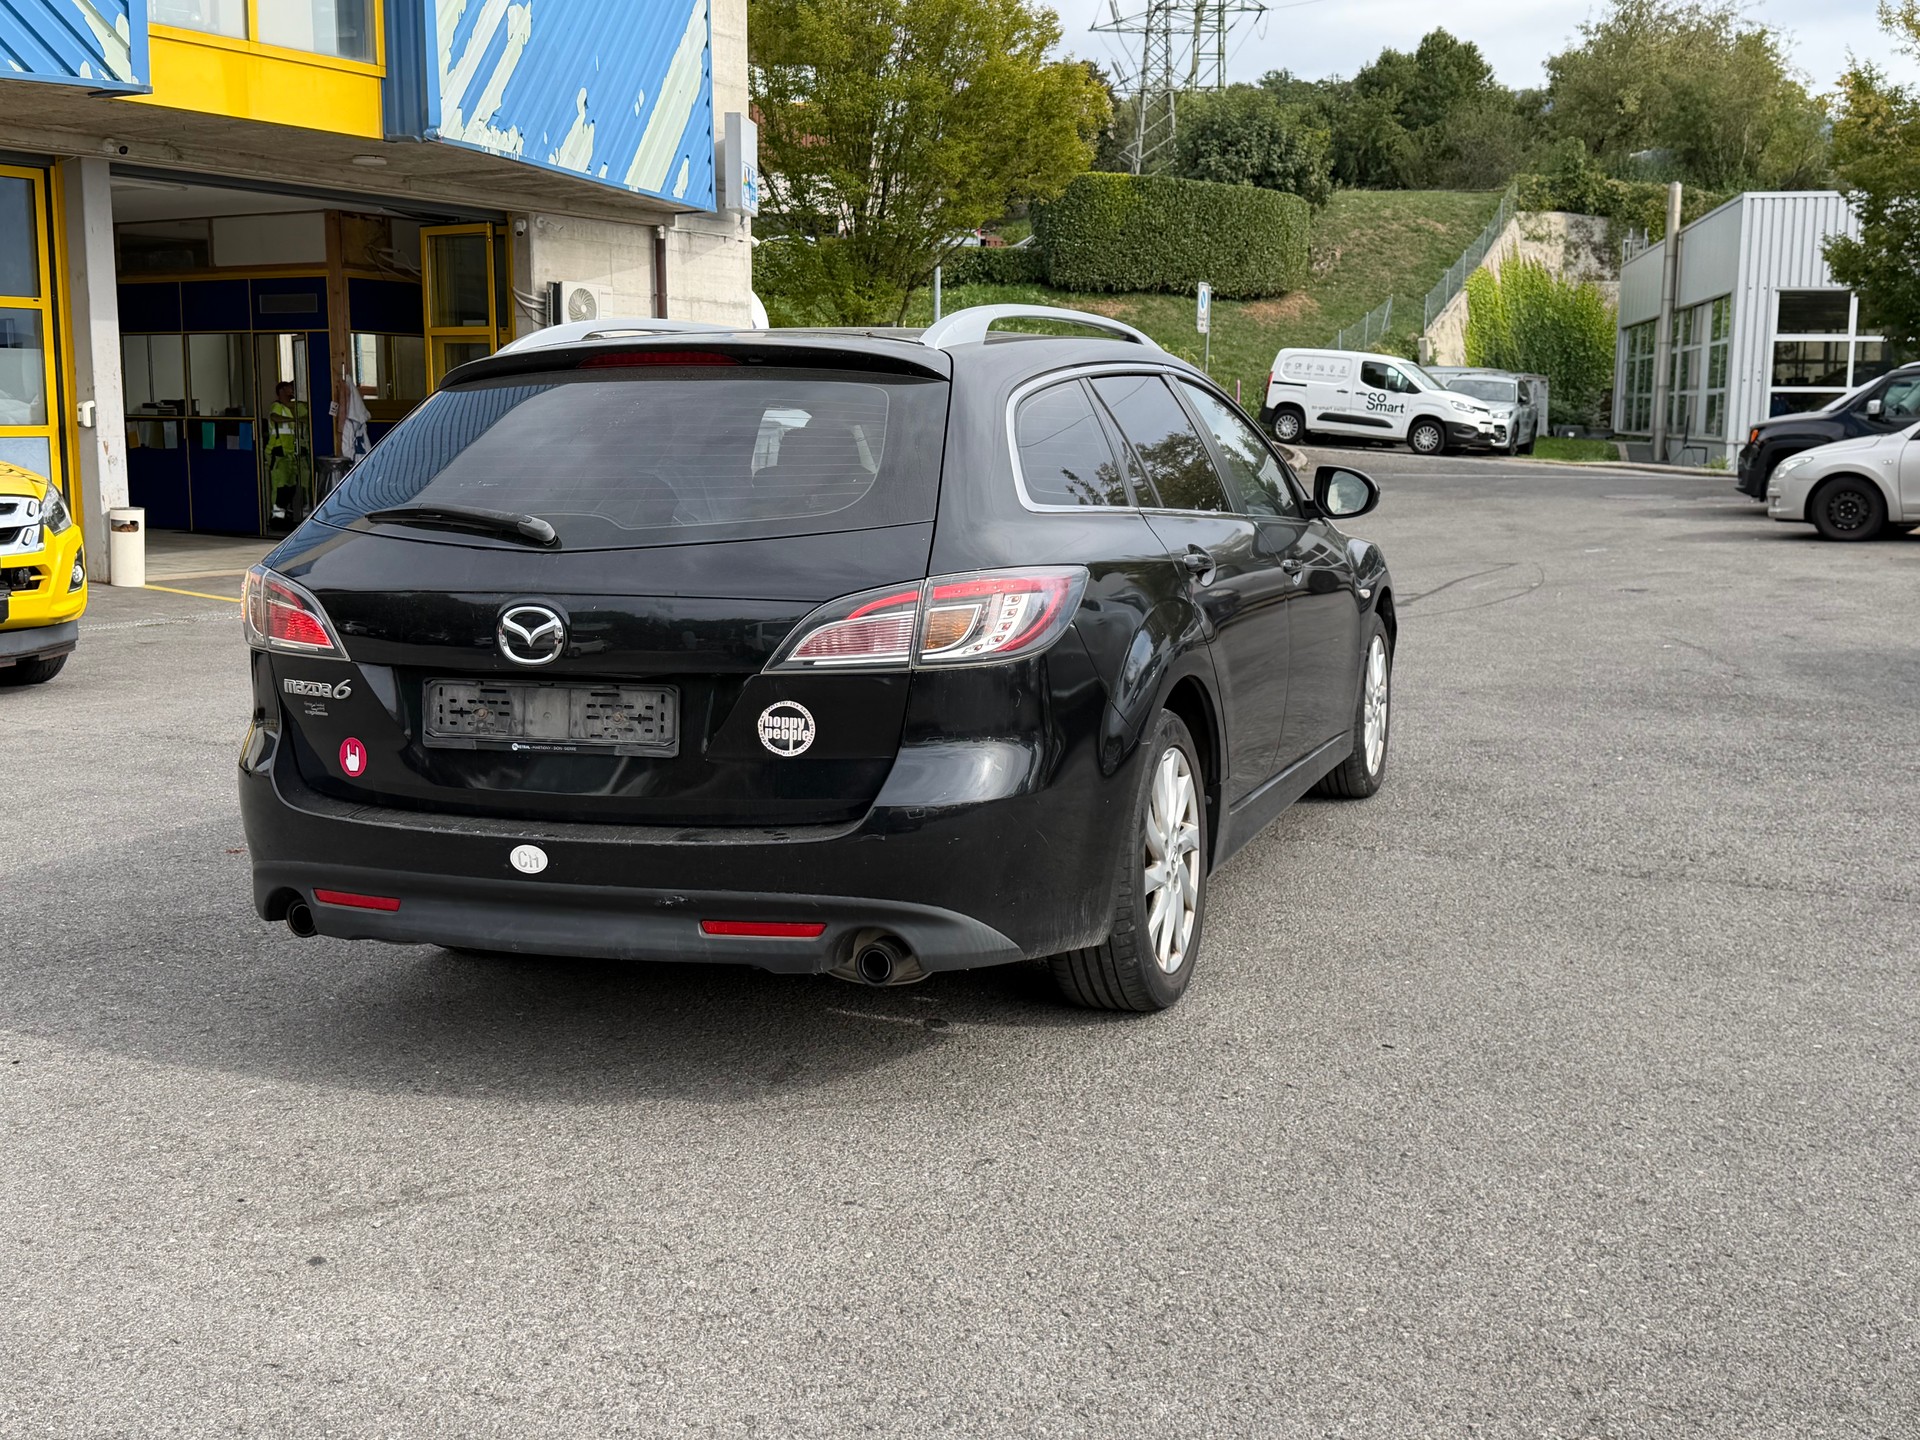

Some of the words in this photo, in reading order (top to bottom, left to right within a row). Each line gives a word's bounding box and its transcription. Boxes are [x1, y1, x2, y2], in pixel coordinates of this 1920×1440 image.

[1366, 400, 1404, 414] Smart
[765, 716, 806, 730] hoppy
[765, 728, 810, 742] people
